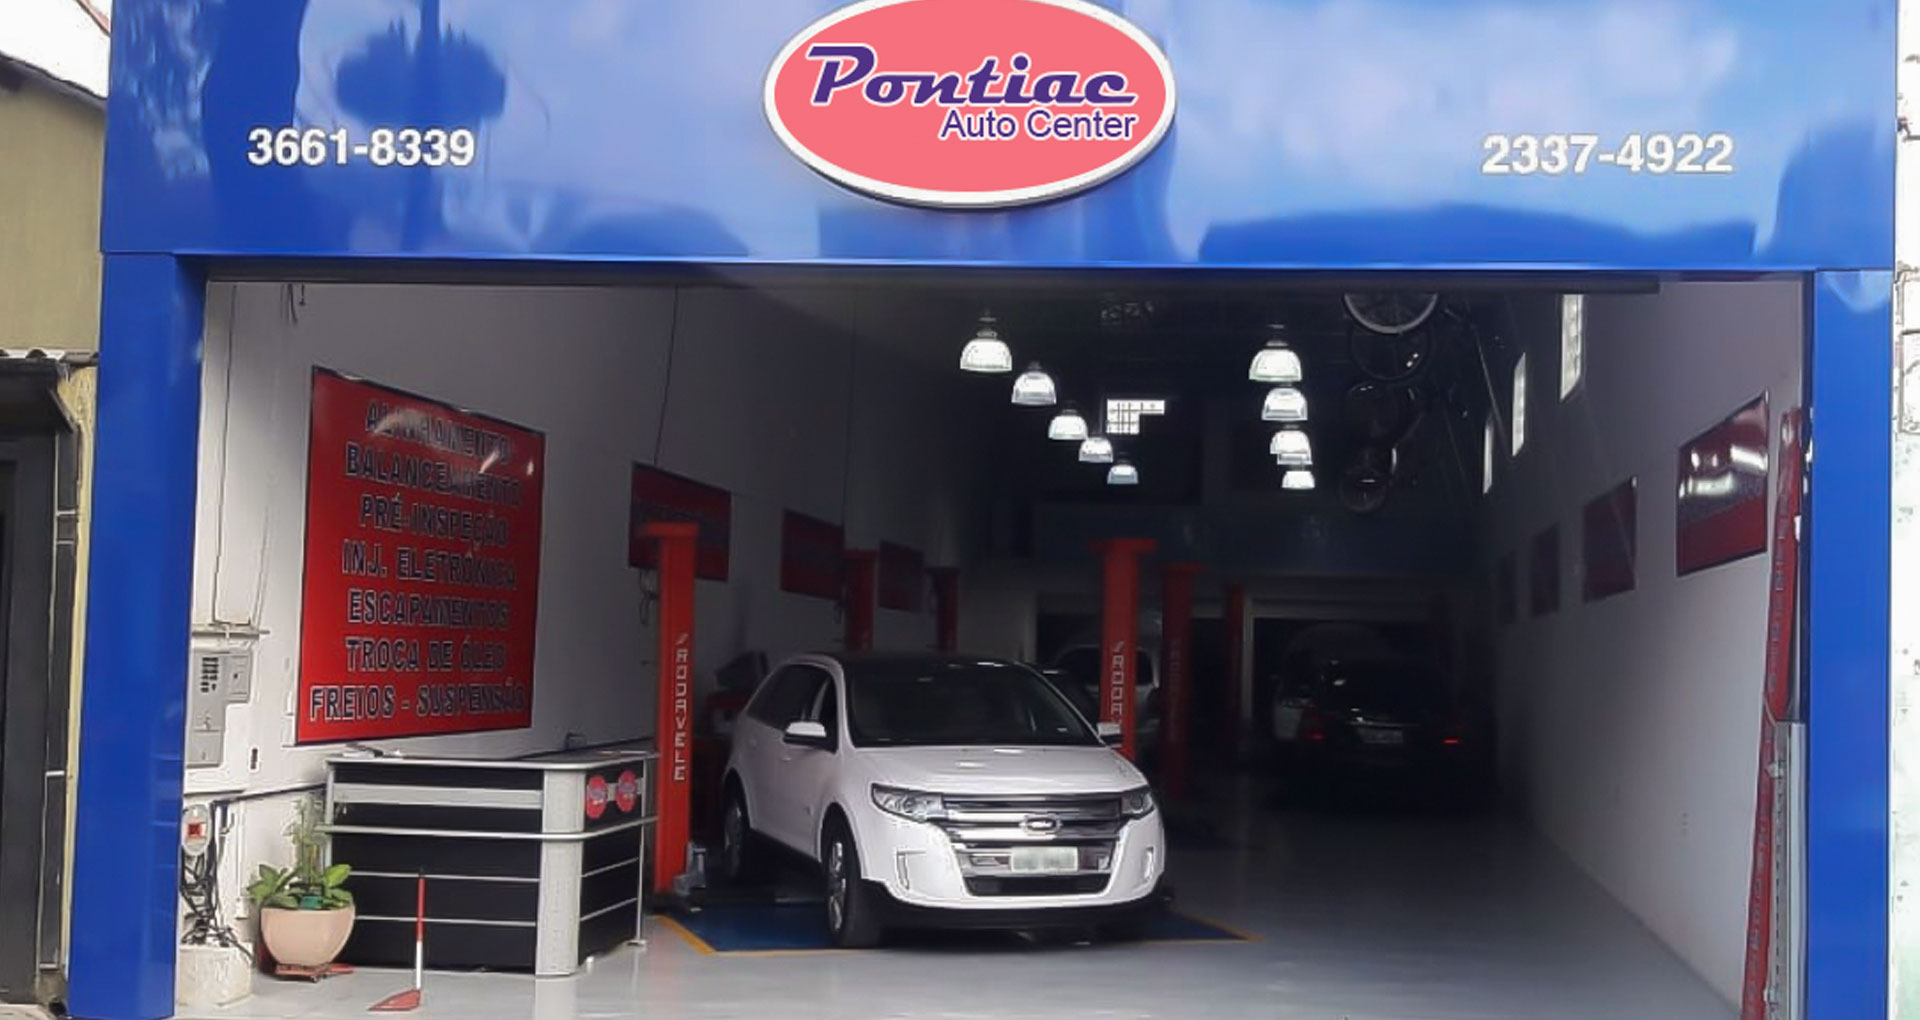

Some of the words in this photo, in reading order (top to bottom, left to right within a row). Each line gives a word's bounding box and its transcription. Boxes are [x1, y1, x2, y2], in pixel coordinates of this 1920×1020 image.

[807, 45, 1137, 104] Pontiac
[940, 109, 1016, 138] Auto
[1026, 109, 1137, 138] Center
[248, 127, 475, 166] 3661-8339
[1481, 133, 1735, 175] 2337-4922
[342, 539, 388, 578] INJ.
[347, 587, 510, 630] ESCAPAMENTOS
[345, 635, 420, 672] TROCA
[428, 640, 454, 673] DE
[460, 634, 507, 673] ÓLEO
[309, 684, 396, 722] FREIOS
[673, 649, 688, 781] RODAVELE
